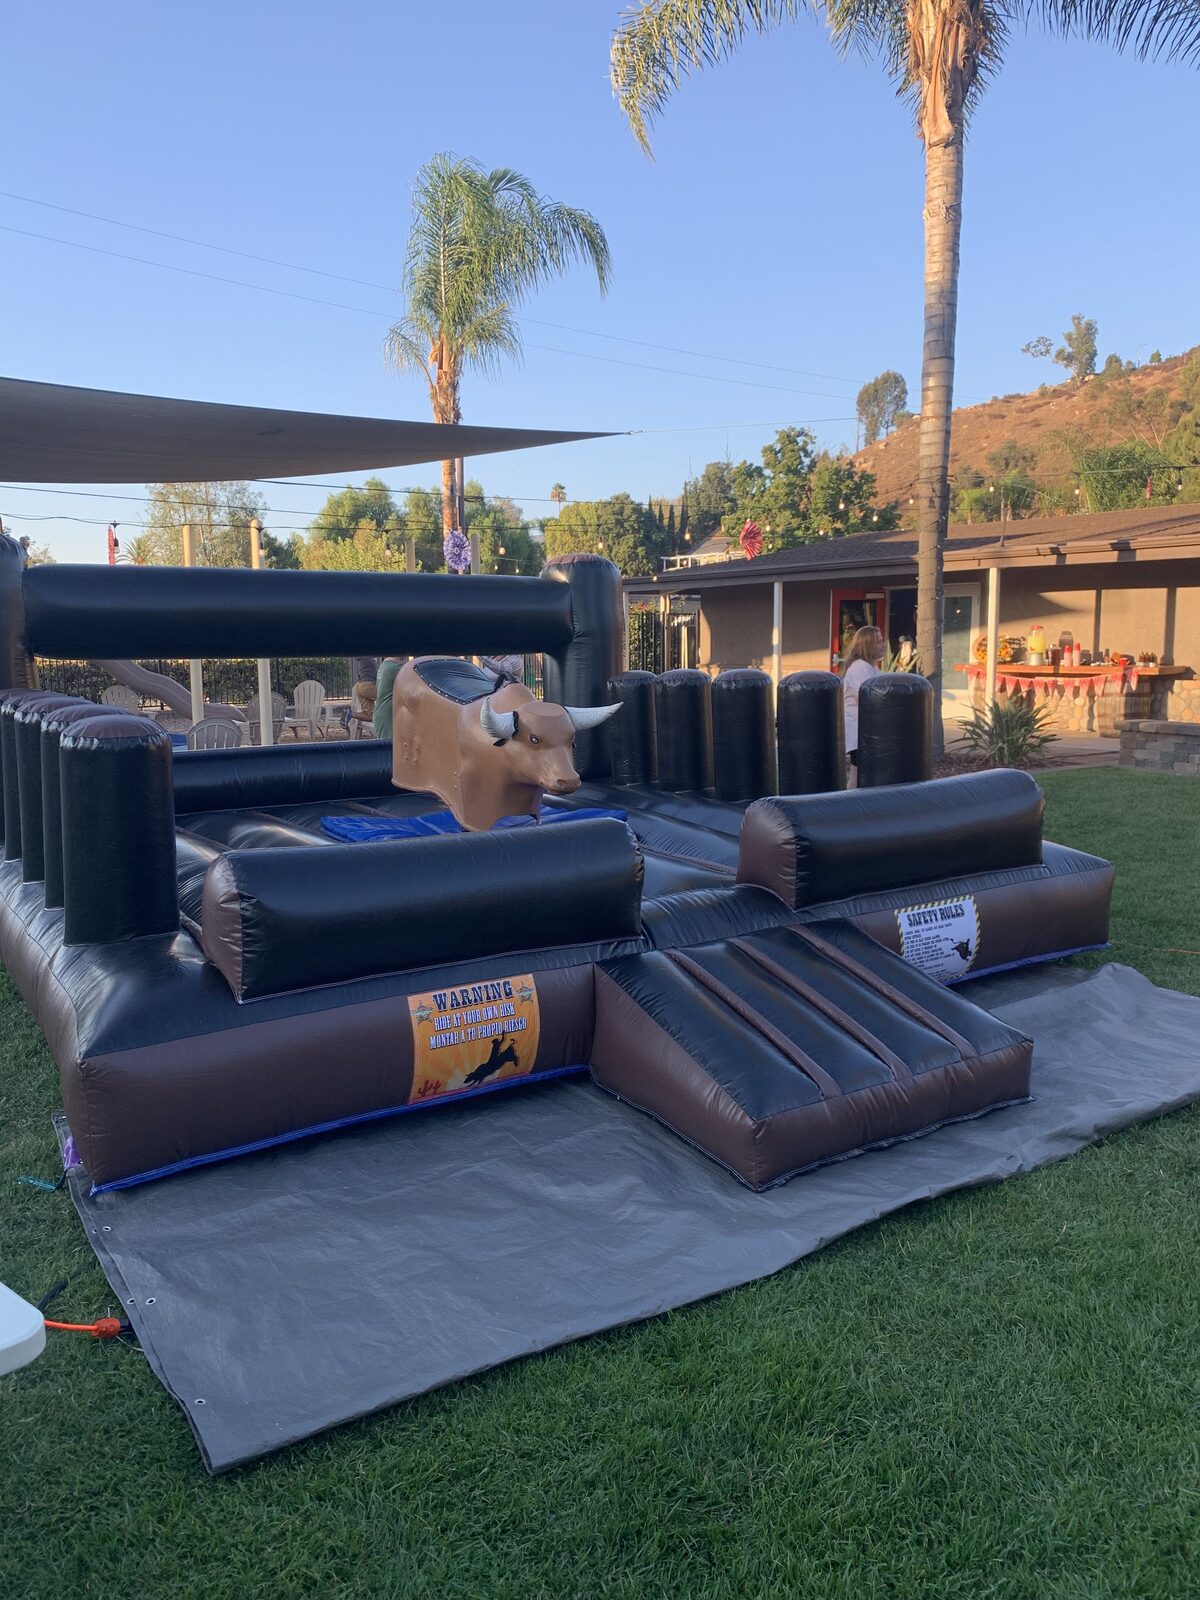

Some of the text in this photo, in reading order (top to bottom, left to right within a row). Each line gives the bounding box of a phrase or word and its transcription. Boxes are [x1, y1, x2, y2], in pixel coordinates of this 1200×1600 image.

[907, 904, 965, 927] SAFETY RULES
[433, 980, 513, 1012] WARNING
[434, 1002, 515, 1031] RIDE AT YOUR OWN RISK
[429, 1017, 527, 1050] MONTAR A TU PROPIO RIESGO
